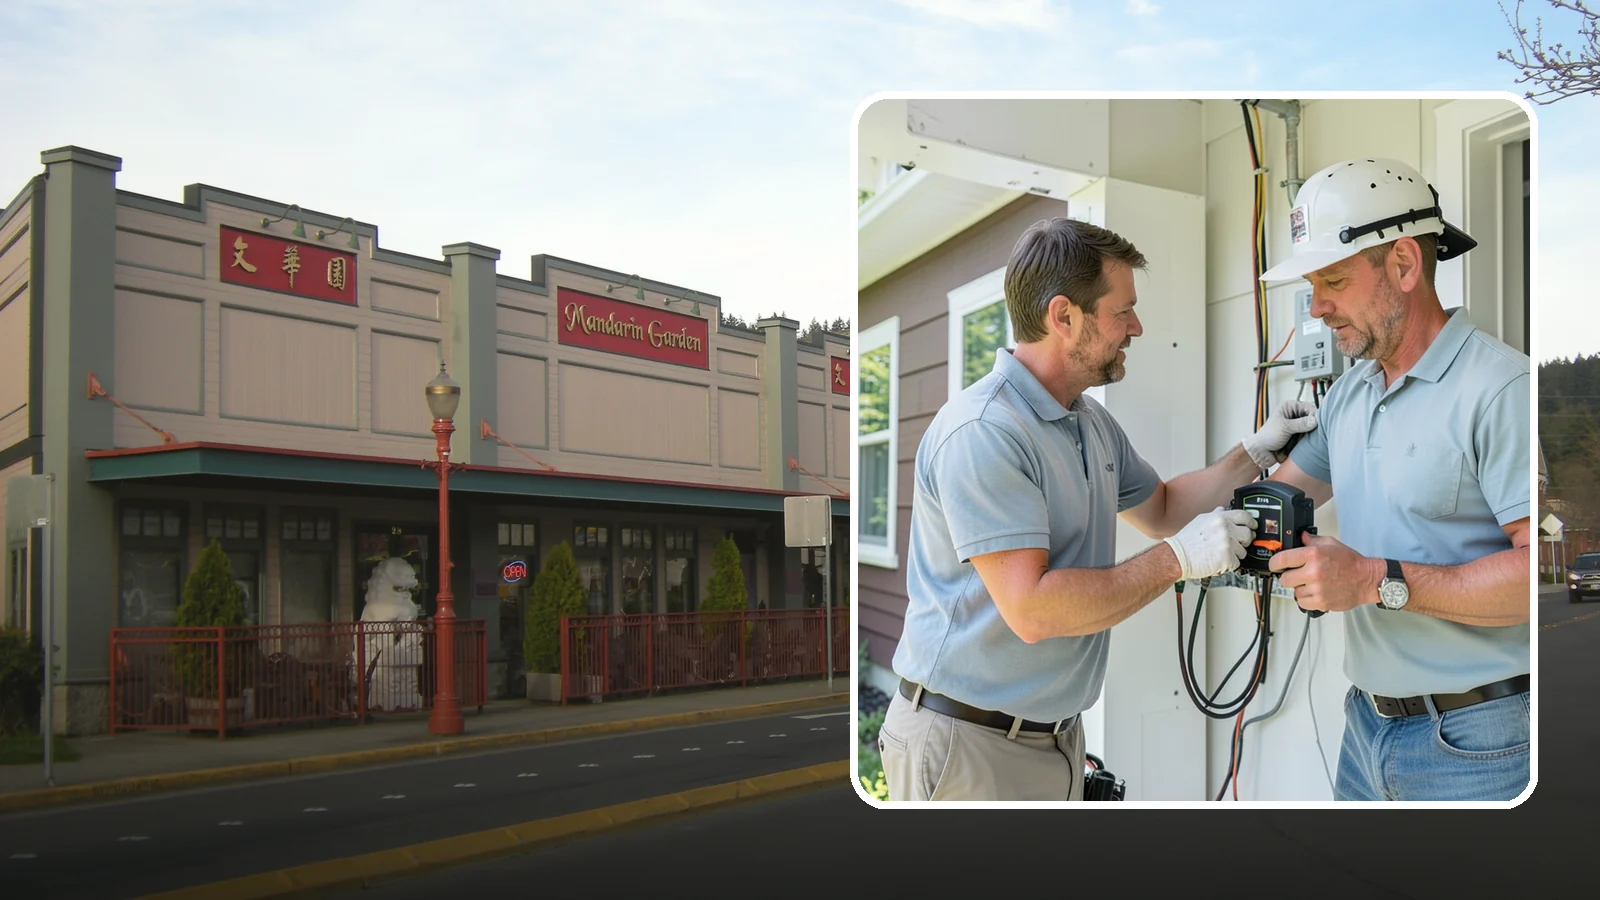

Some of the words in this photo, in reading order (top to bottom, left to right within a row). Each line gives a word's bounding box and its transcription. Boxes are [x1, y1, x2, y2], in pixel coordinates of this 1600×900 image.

[230, 235, 347, 291] 文華園
[564, 302, 644, 340] Mandarin
[648, 319, 702, 352] Garden
[834, 363, 847, 386] 文
[503, 565, 527, 578] OPEN
